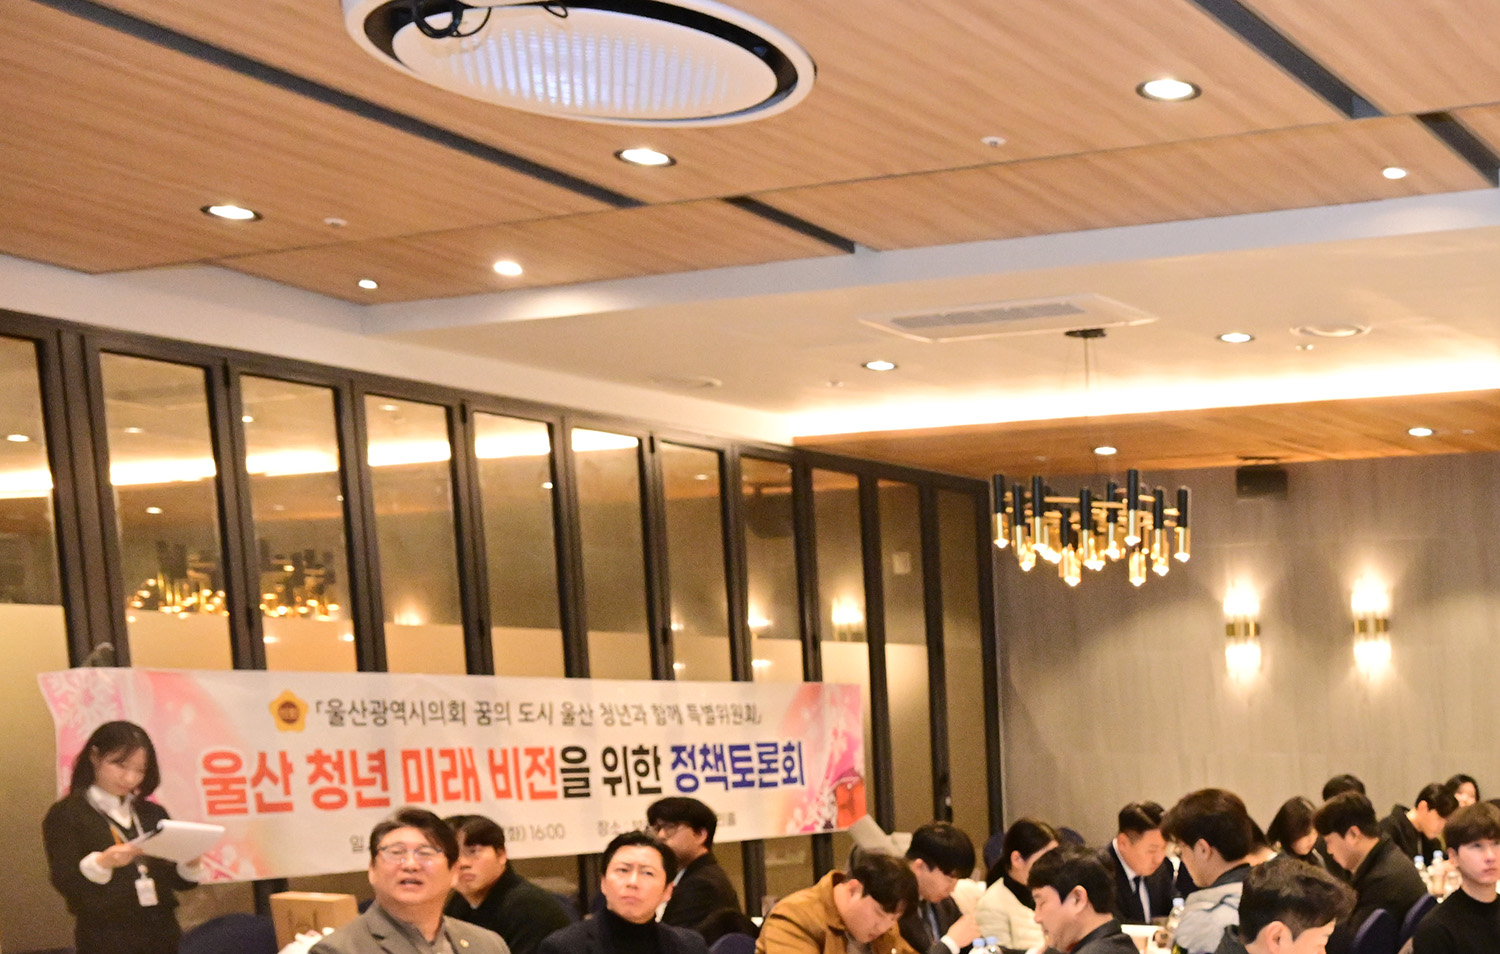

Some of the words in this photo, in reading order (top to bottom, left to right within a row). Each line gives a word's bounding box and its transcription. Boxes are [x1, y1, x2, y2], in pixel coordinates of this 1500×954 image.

[473, 700, 512, 726] 꿈의
[518, 700, 554, 725] 도시
[560, 702, 594, 726] 울산
[600, 702, 648, 727] 청년과
[652, 702, 683, 726] 함께
[201, 750, 294, 816] 울산
[305, 747, 390, 810] 청년
[400, 747, 482, 804] 미래
[487, 745, 591, 801] 비전을
[601, 744, 662, 797] 위한
[669, 740, 805, 793] 정책토론회
